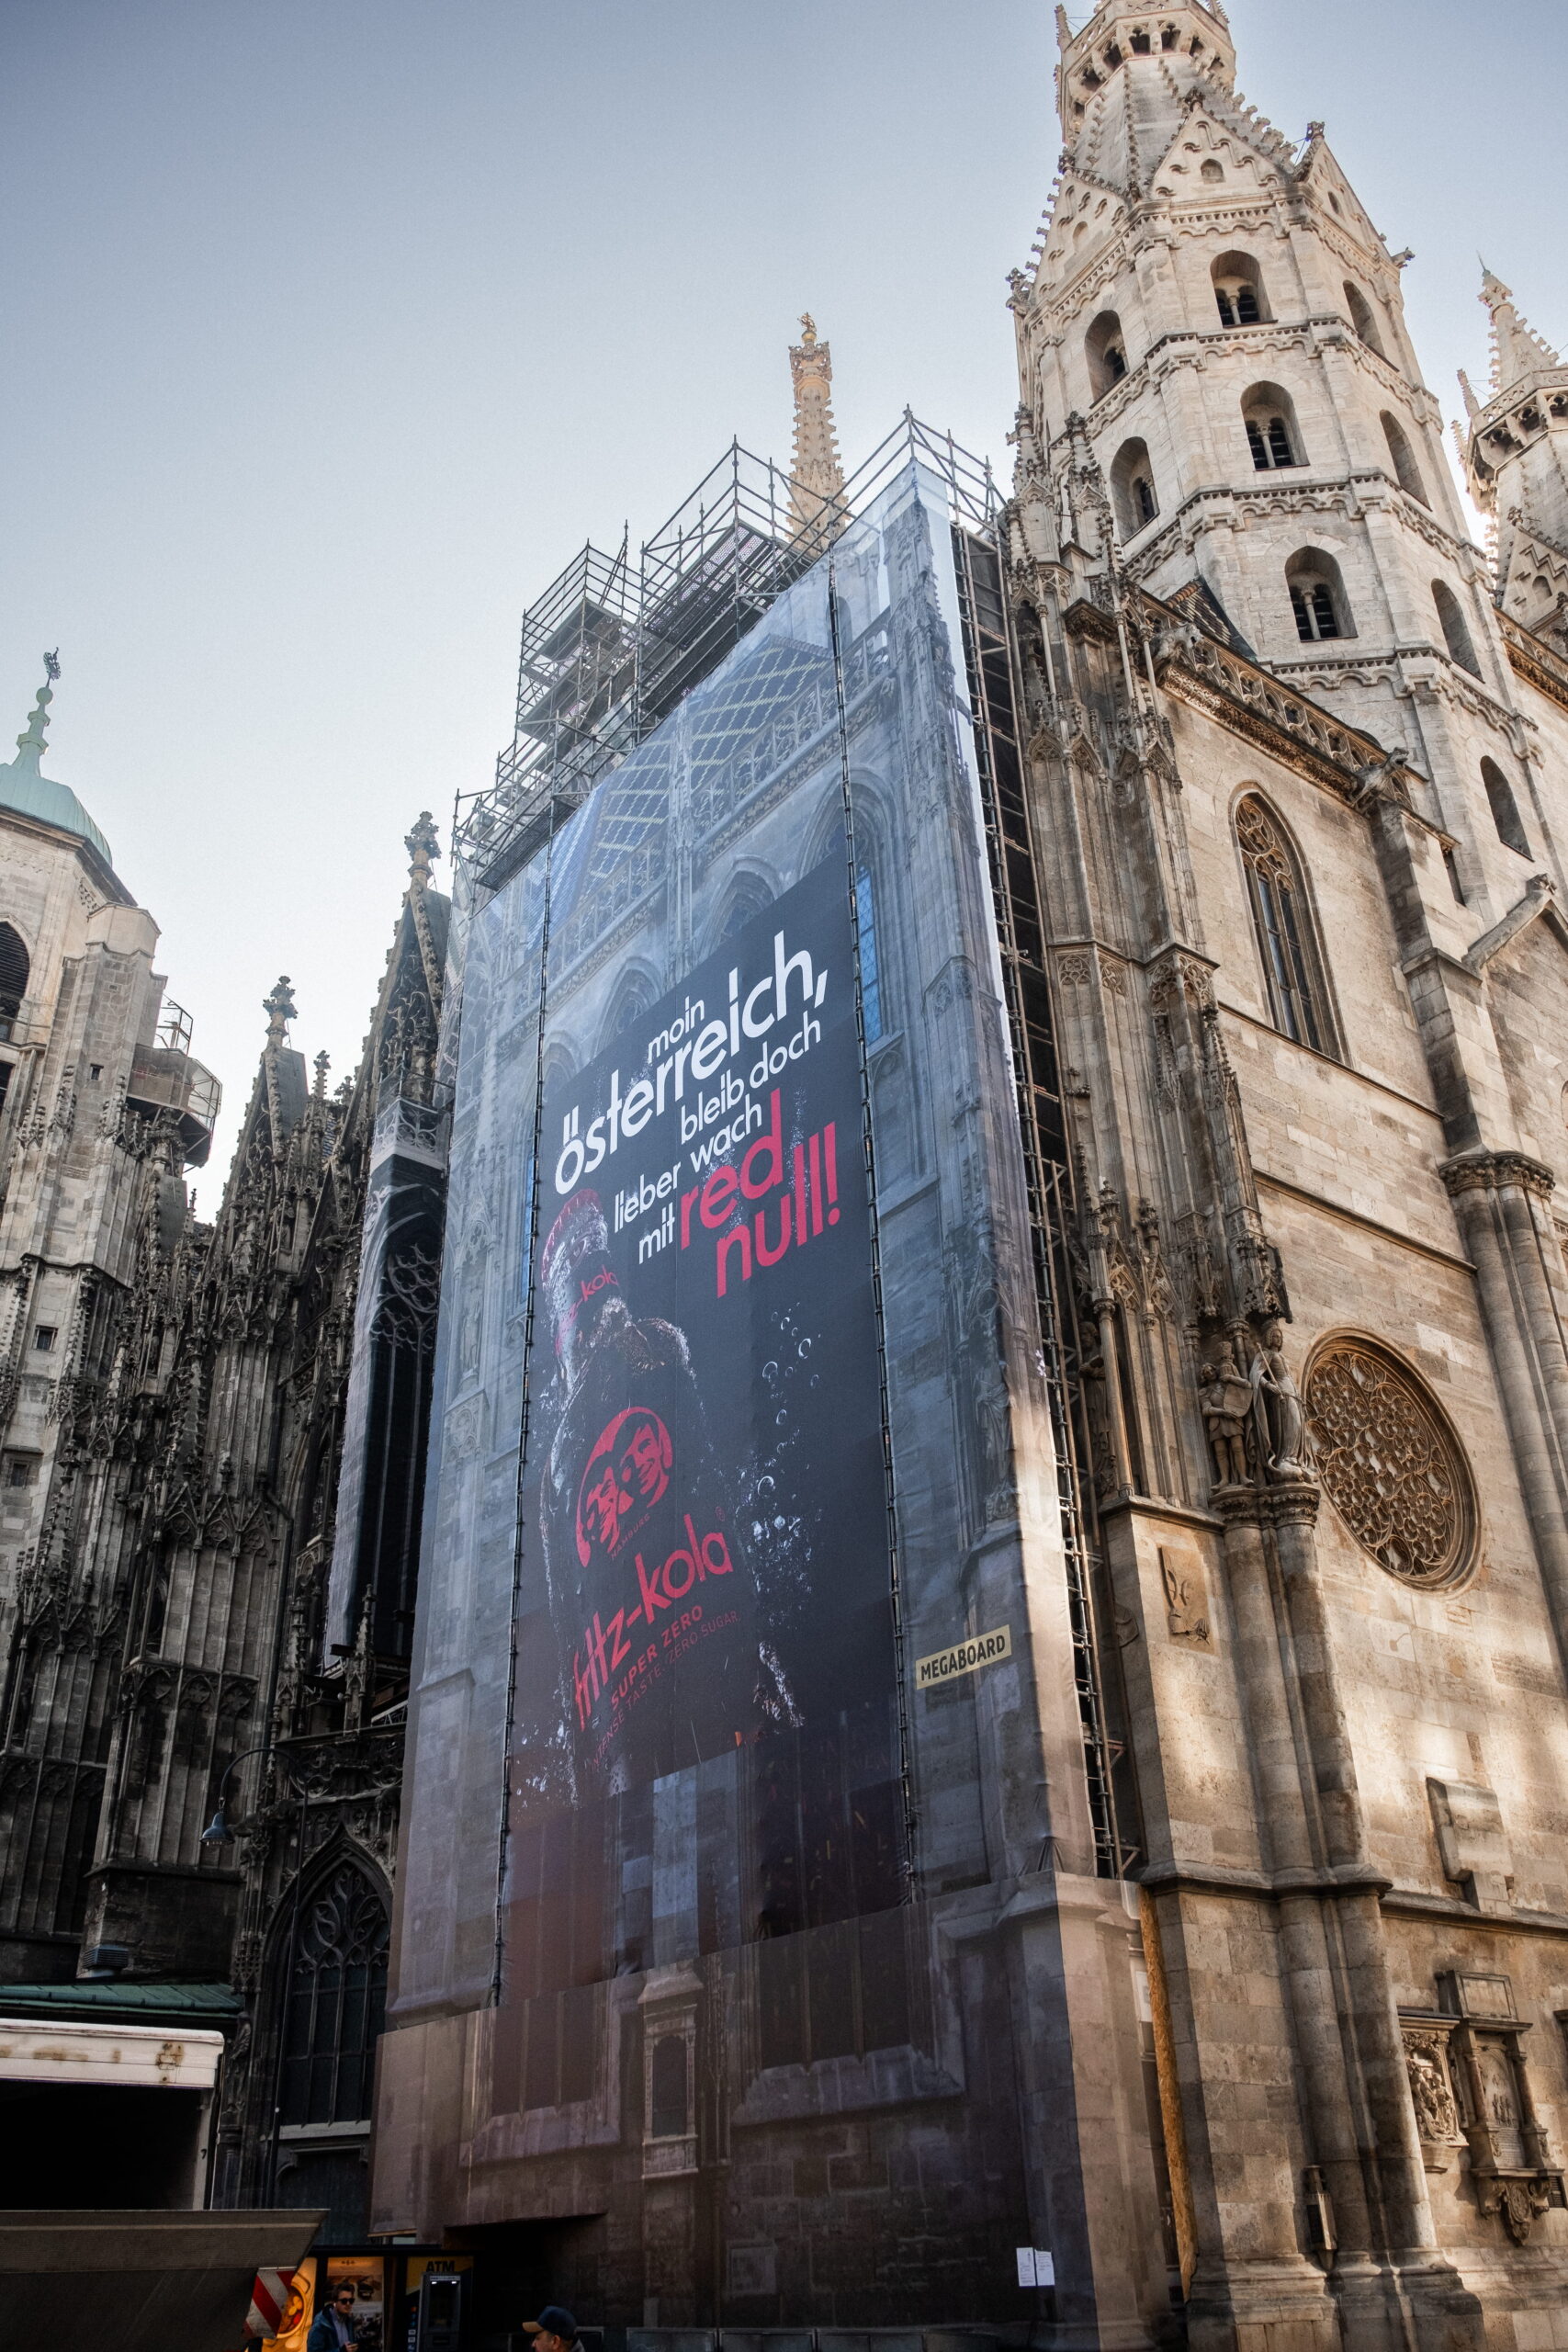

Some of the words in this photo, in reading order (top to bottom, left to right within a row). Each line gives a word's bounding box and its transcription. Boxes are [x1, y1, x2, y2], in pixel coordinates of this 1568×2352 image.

[555, 929, 828, 1195] österreich,
[647, 996, 705, 1065] moin
[680, 1069, 745, 1145] bleib
[749, 1012, 821, 1090] doch
[614, 1162, 682, 1233] lieber
[690, 1094, 762, 1174] wach
[638, 1202, 675, 1264] mit
[680, 1088, 784, 1250] red
[716, 1122, 840, 1298] null!
[573, 1513, 734, 1732] fritz-kola
[611, 1643, 658, 1712] SUPER
[661, 1605, 704, 1647] ZERO
[668, 1632, 698, 1665] ZERO
[920, 1634, 1006, 1681] MEGABOARD
[426, 2260, 456, 2273] ATM
